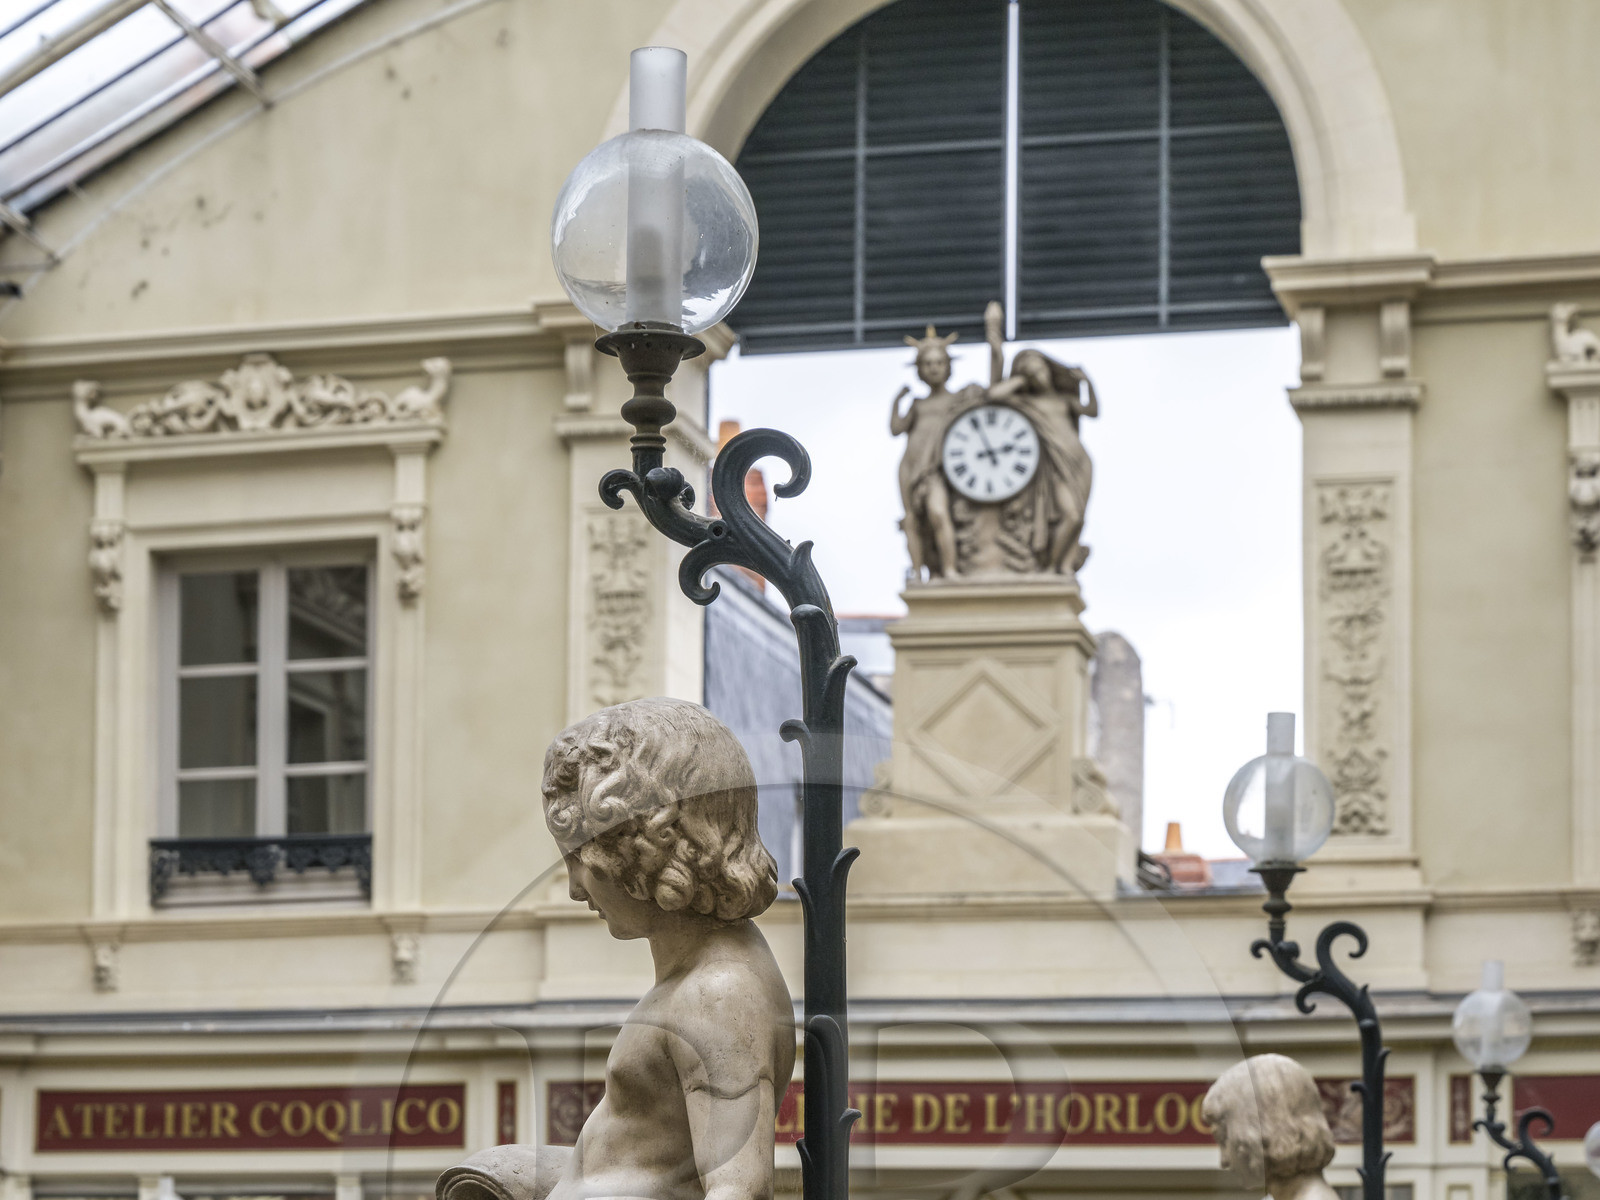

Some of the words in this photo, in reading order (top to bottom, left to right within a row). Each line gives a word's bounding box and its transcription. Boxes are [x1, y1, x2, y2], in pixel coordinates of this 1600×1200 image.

[44, 1102, 240, 1139] ATELIER
[250, 1097, 461, 1142] COQLICO
[912, 1092, 971, 1134] DE
